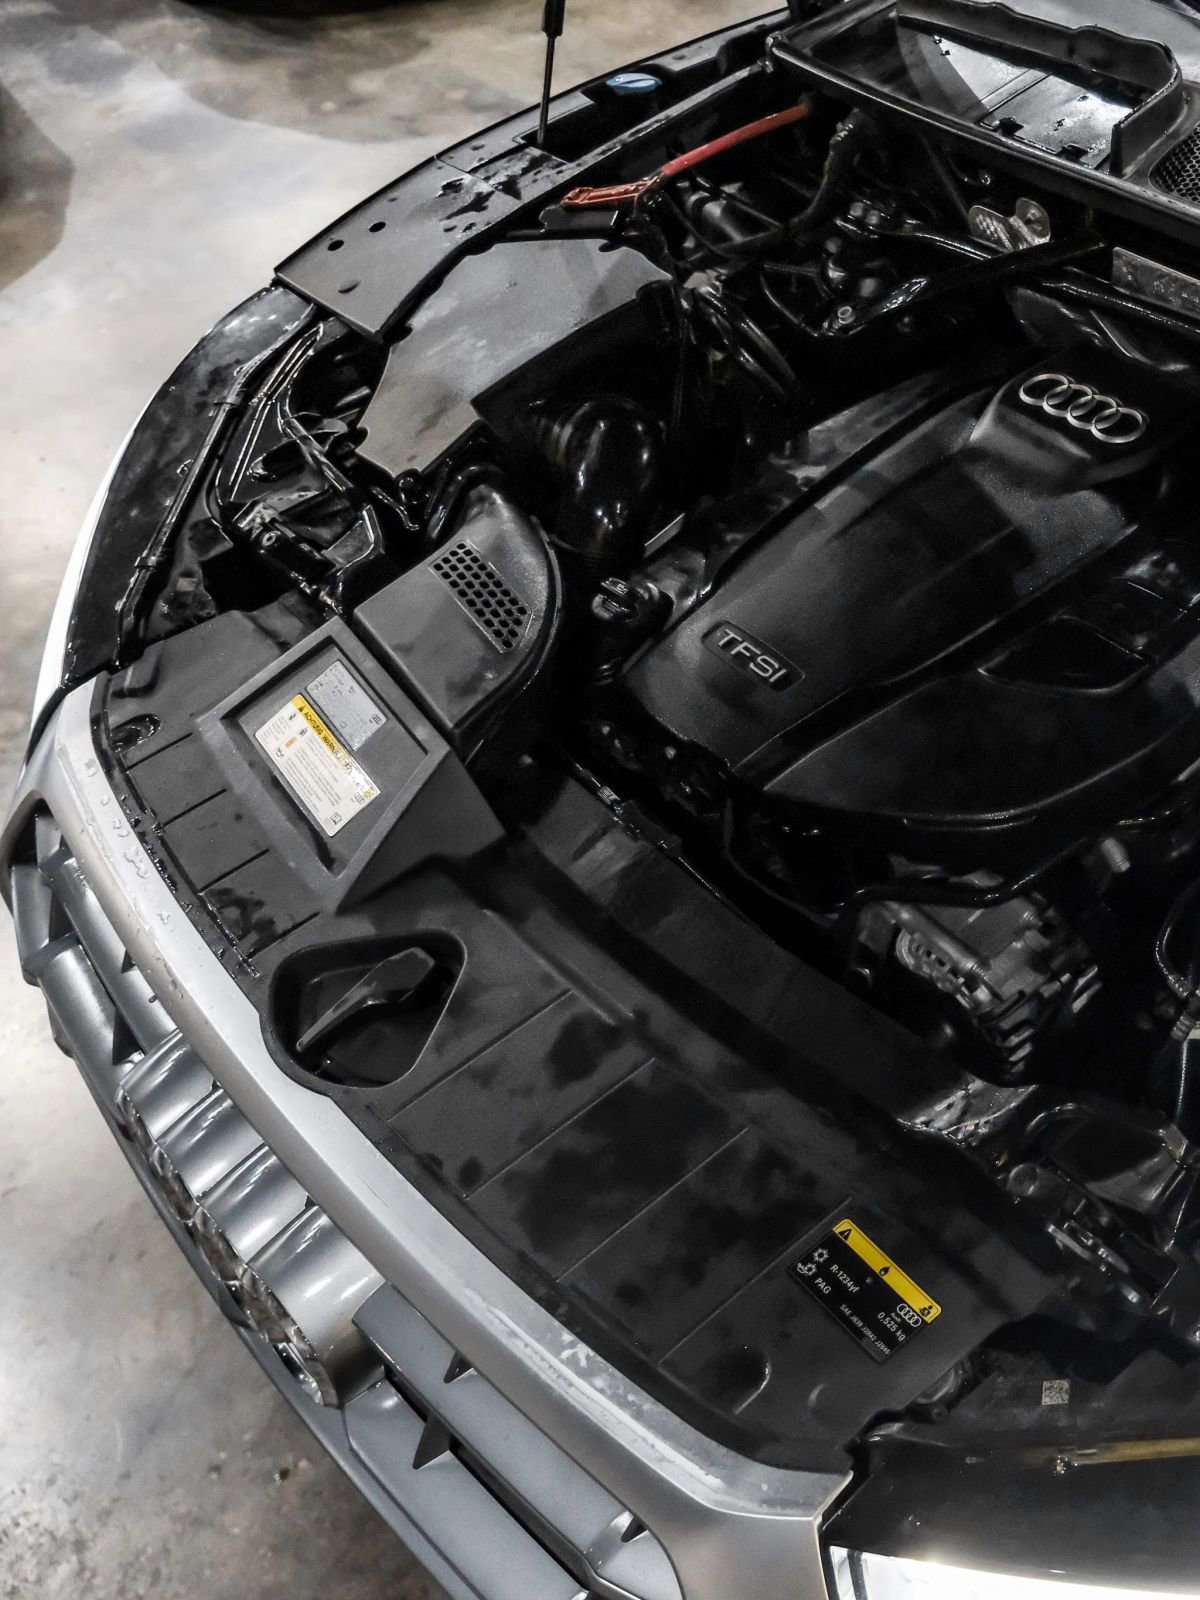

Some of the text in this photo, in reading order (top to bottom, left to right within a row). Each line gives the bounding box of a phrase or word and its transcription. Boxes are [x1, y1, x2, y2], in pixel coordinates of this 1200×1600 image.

[718, 628, 787, 683] TFSI
[304, 711, 324, 736] ACHTUNG
[814, 1277, 832, 1295] PAG
[829, 1264, 861, 1294] R-1234yf
[839, 1304, 852, 1316] SAE
[877, 1311, 906, 1342] 0,525 kg
